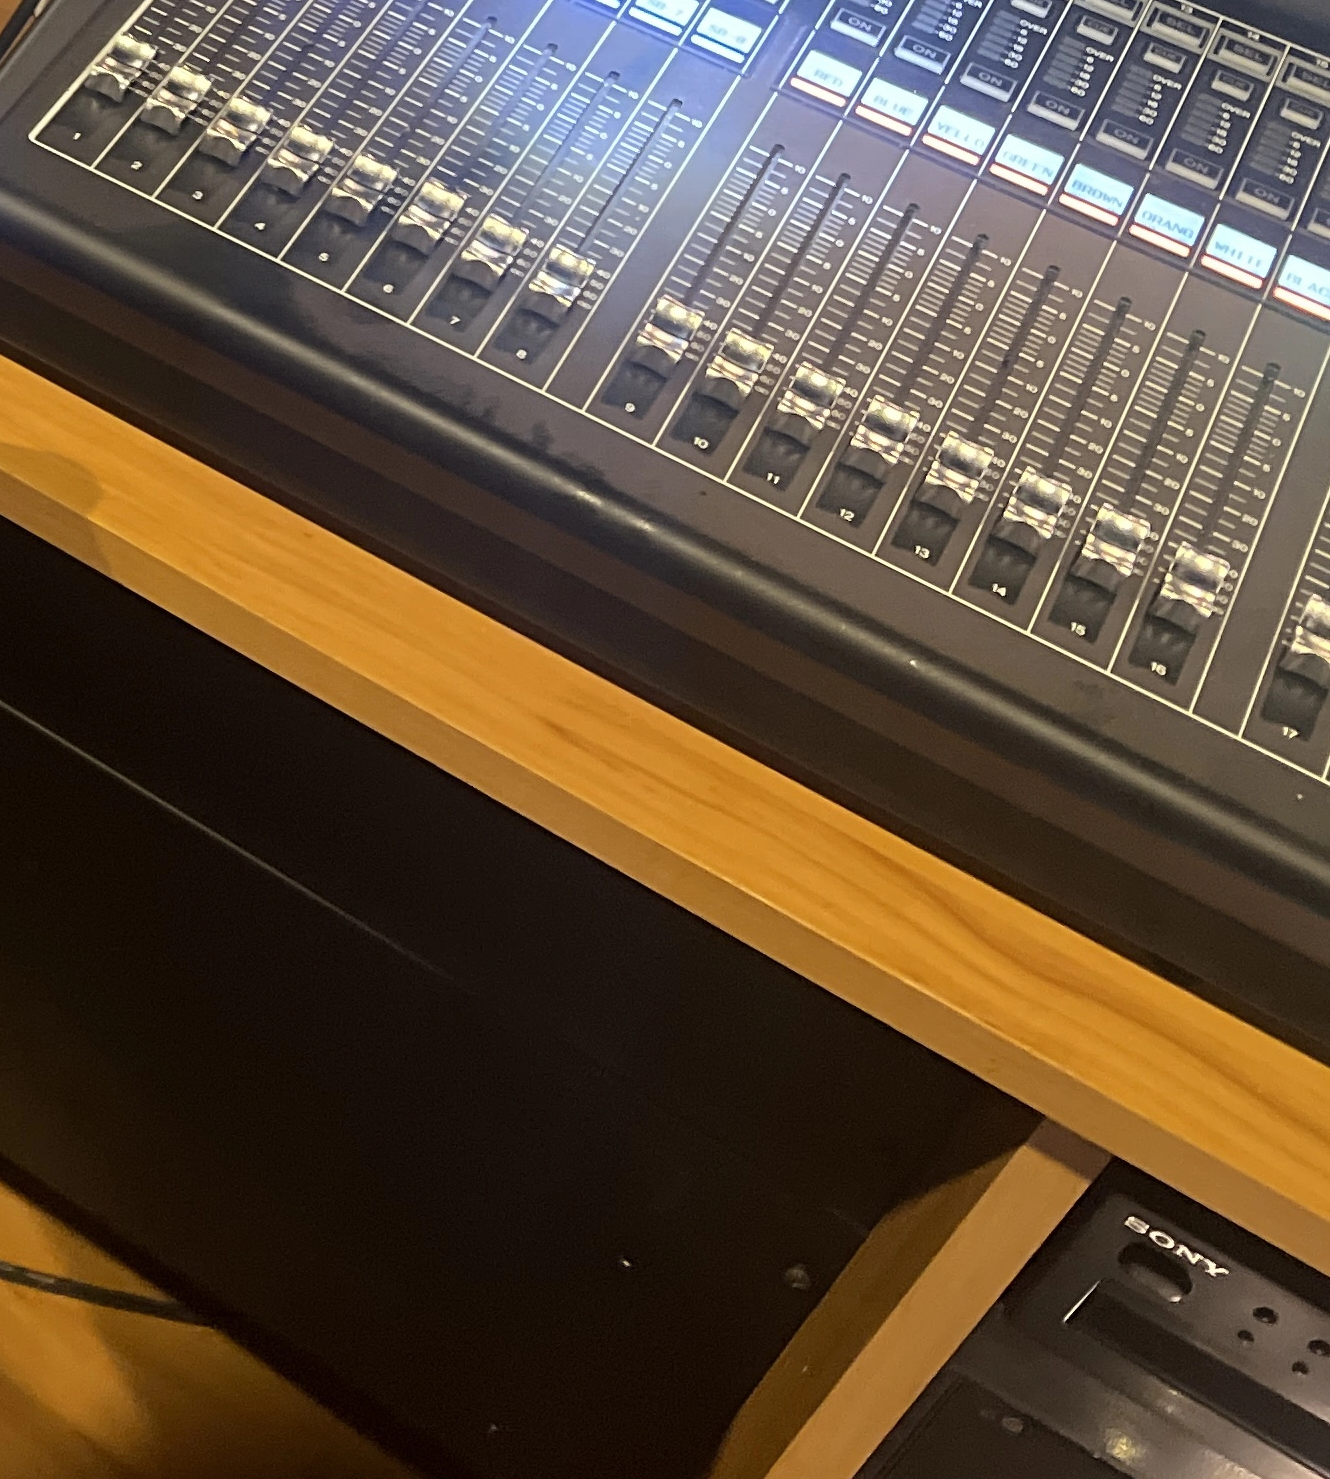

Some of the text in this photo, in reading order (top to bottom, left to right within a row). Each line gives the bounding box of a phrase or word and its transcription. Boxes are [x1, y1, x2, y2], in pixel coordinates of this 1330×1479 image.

[848, 17, 872, 32] ON
[979, 71, 1003, 87] ON
[72, 132, 82, 140] 1
[1113, 128, 1139, 145] ON
[130, 160, 143, 170] 2
[1003, 151, 1055, 178] GREEN
[1071, 179, 1123, 209] BROWN
[1254, 188, 1279, 205] ON
[254, 222, 266, 231] 4
[1141, 210, 1195, 239] ORANG
[318, 252, 329, 262] 5
[1214, 241, 1263, 268] WHITE
[449, 315, 461, 325] 7
[624, 402, 636, 413] 9
[693, 436, 709, 450] 10
[766, 472, 781, 485] 11
[839, 508, 855, 522] 12
[914, 545, 930, 559] 13
[992, 583, 1007, 597] 14
[1124, 1215, 1230, 1278] SONY
